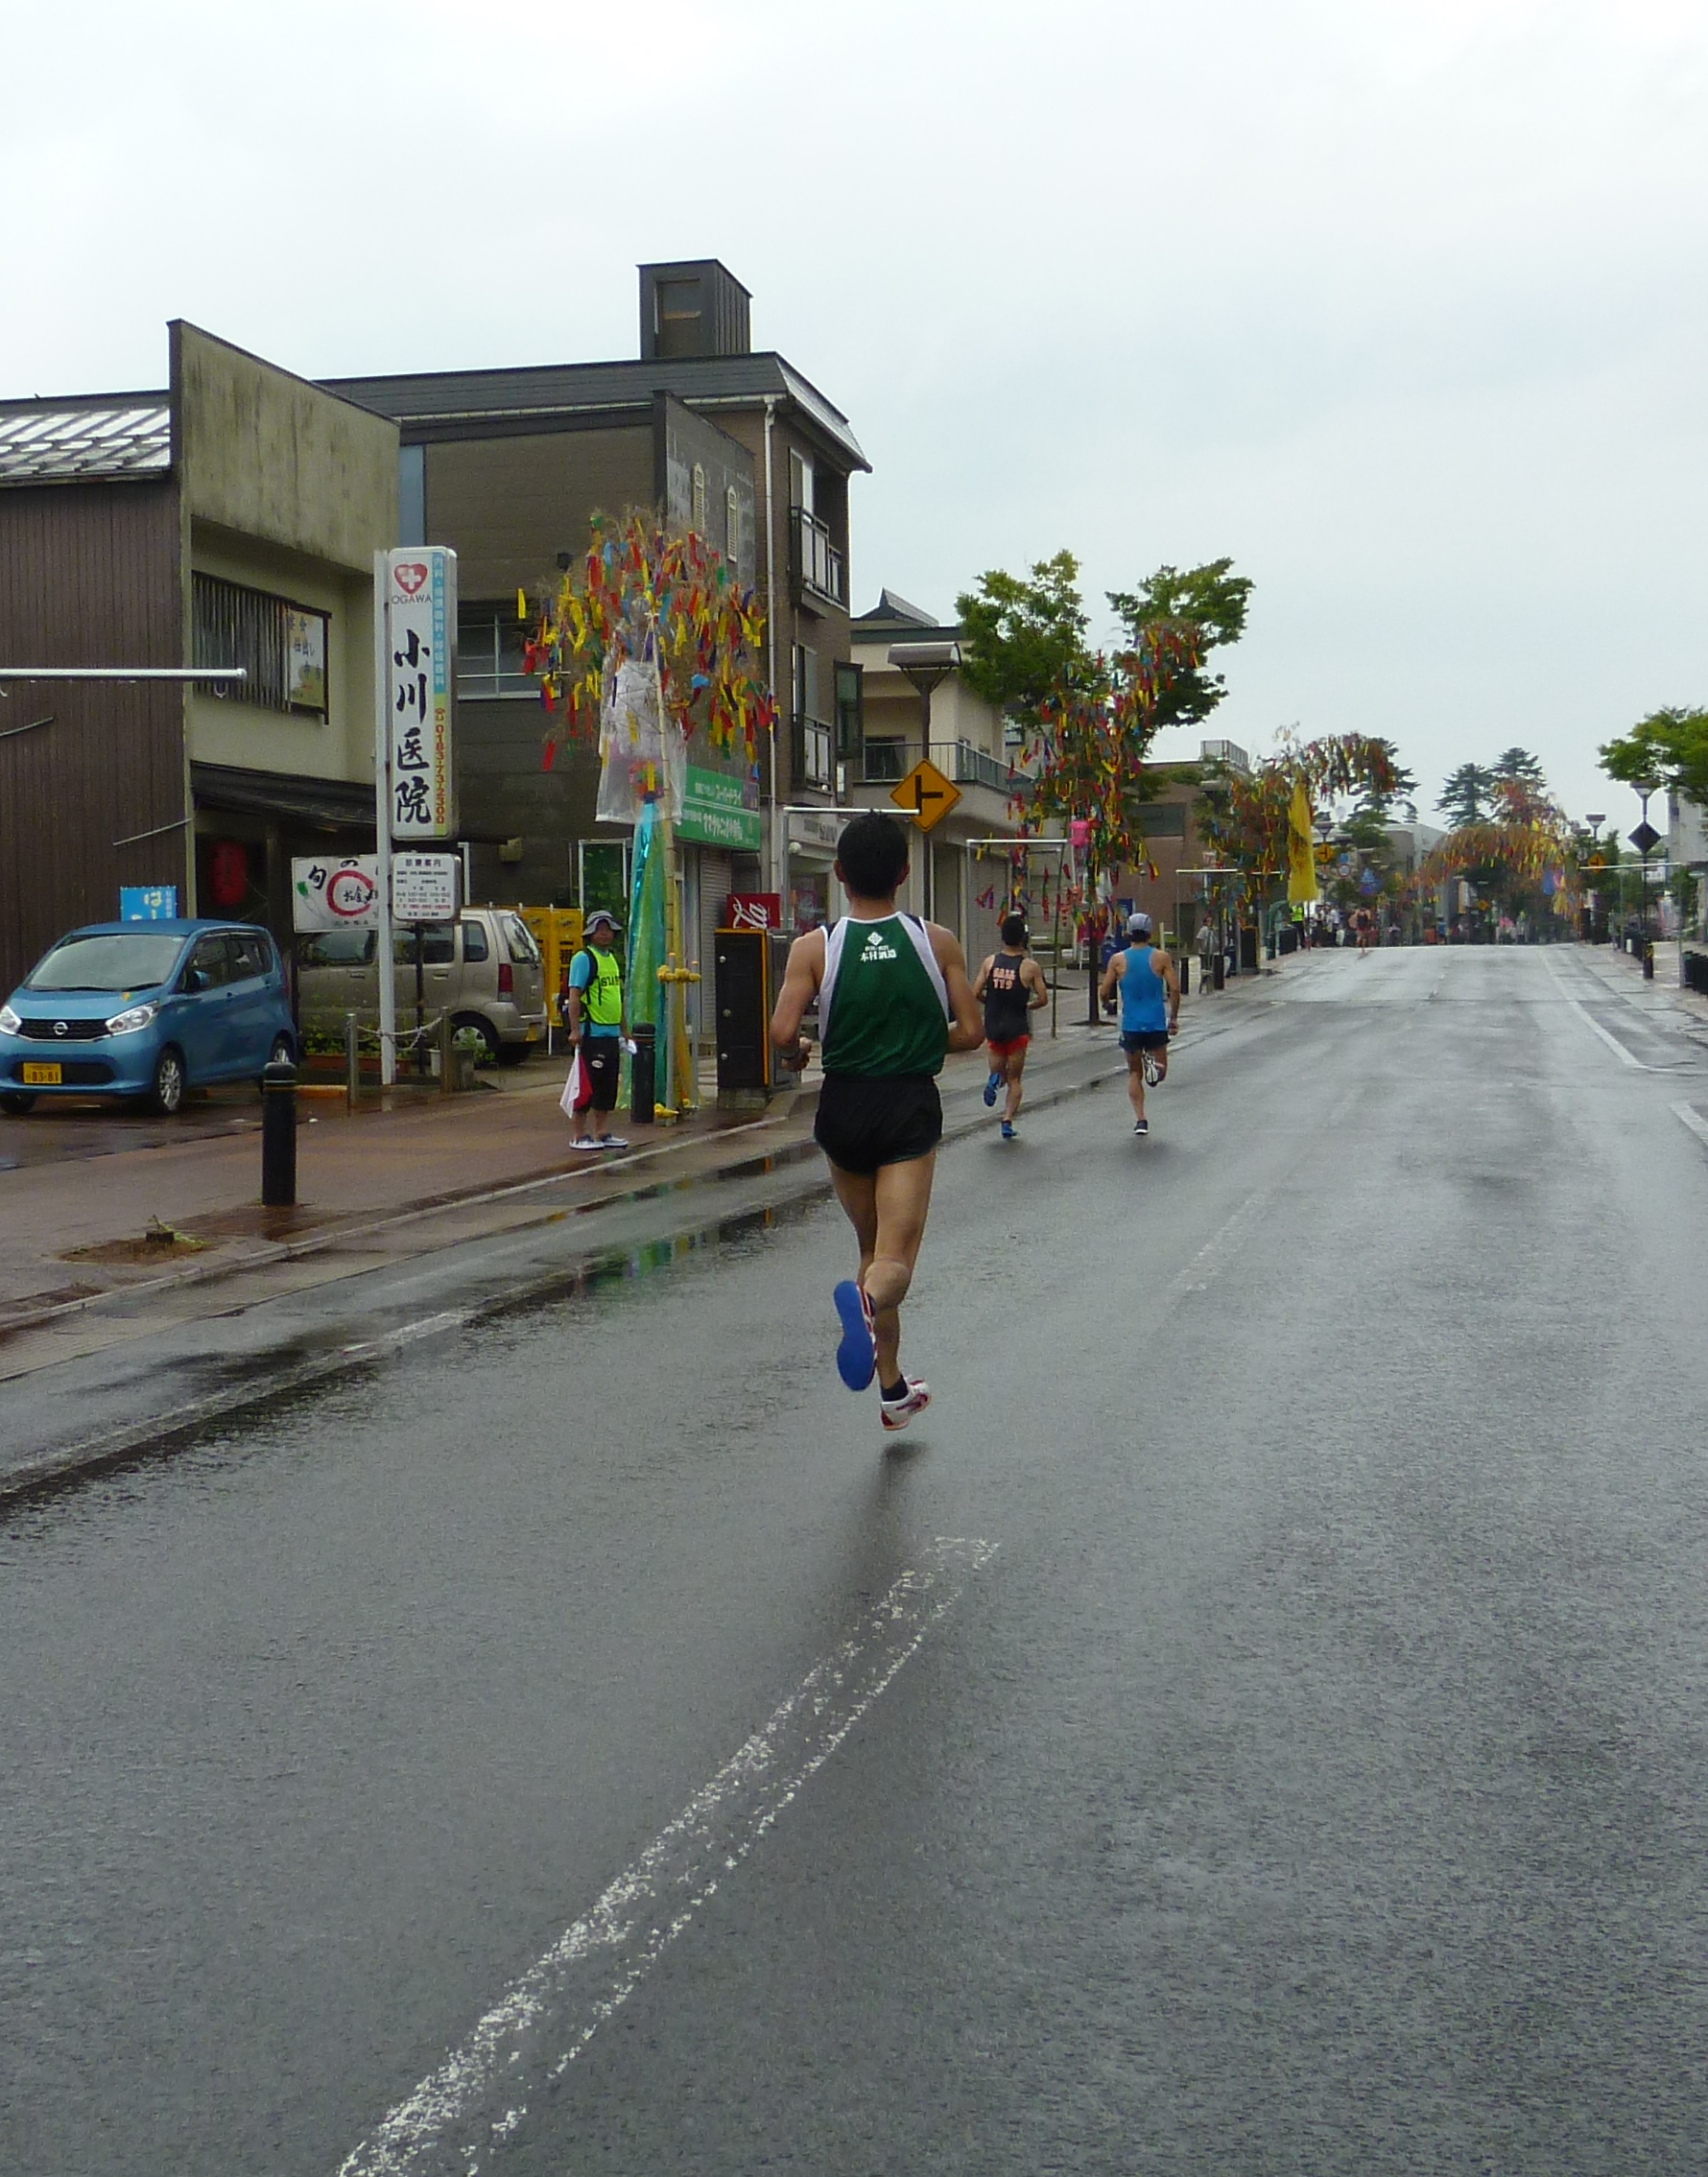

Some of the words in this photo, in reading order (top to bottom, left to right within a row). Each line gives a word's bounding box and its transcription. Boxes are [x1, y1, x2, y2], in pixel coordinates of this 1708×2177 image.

[391, 594, 432, 603] OGAWA
[393, 628, 432, 824] 小川医院
[436, 724, 445, 824] 0183-73-2300
